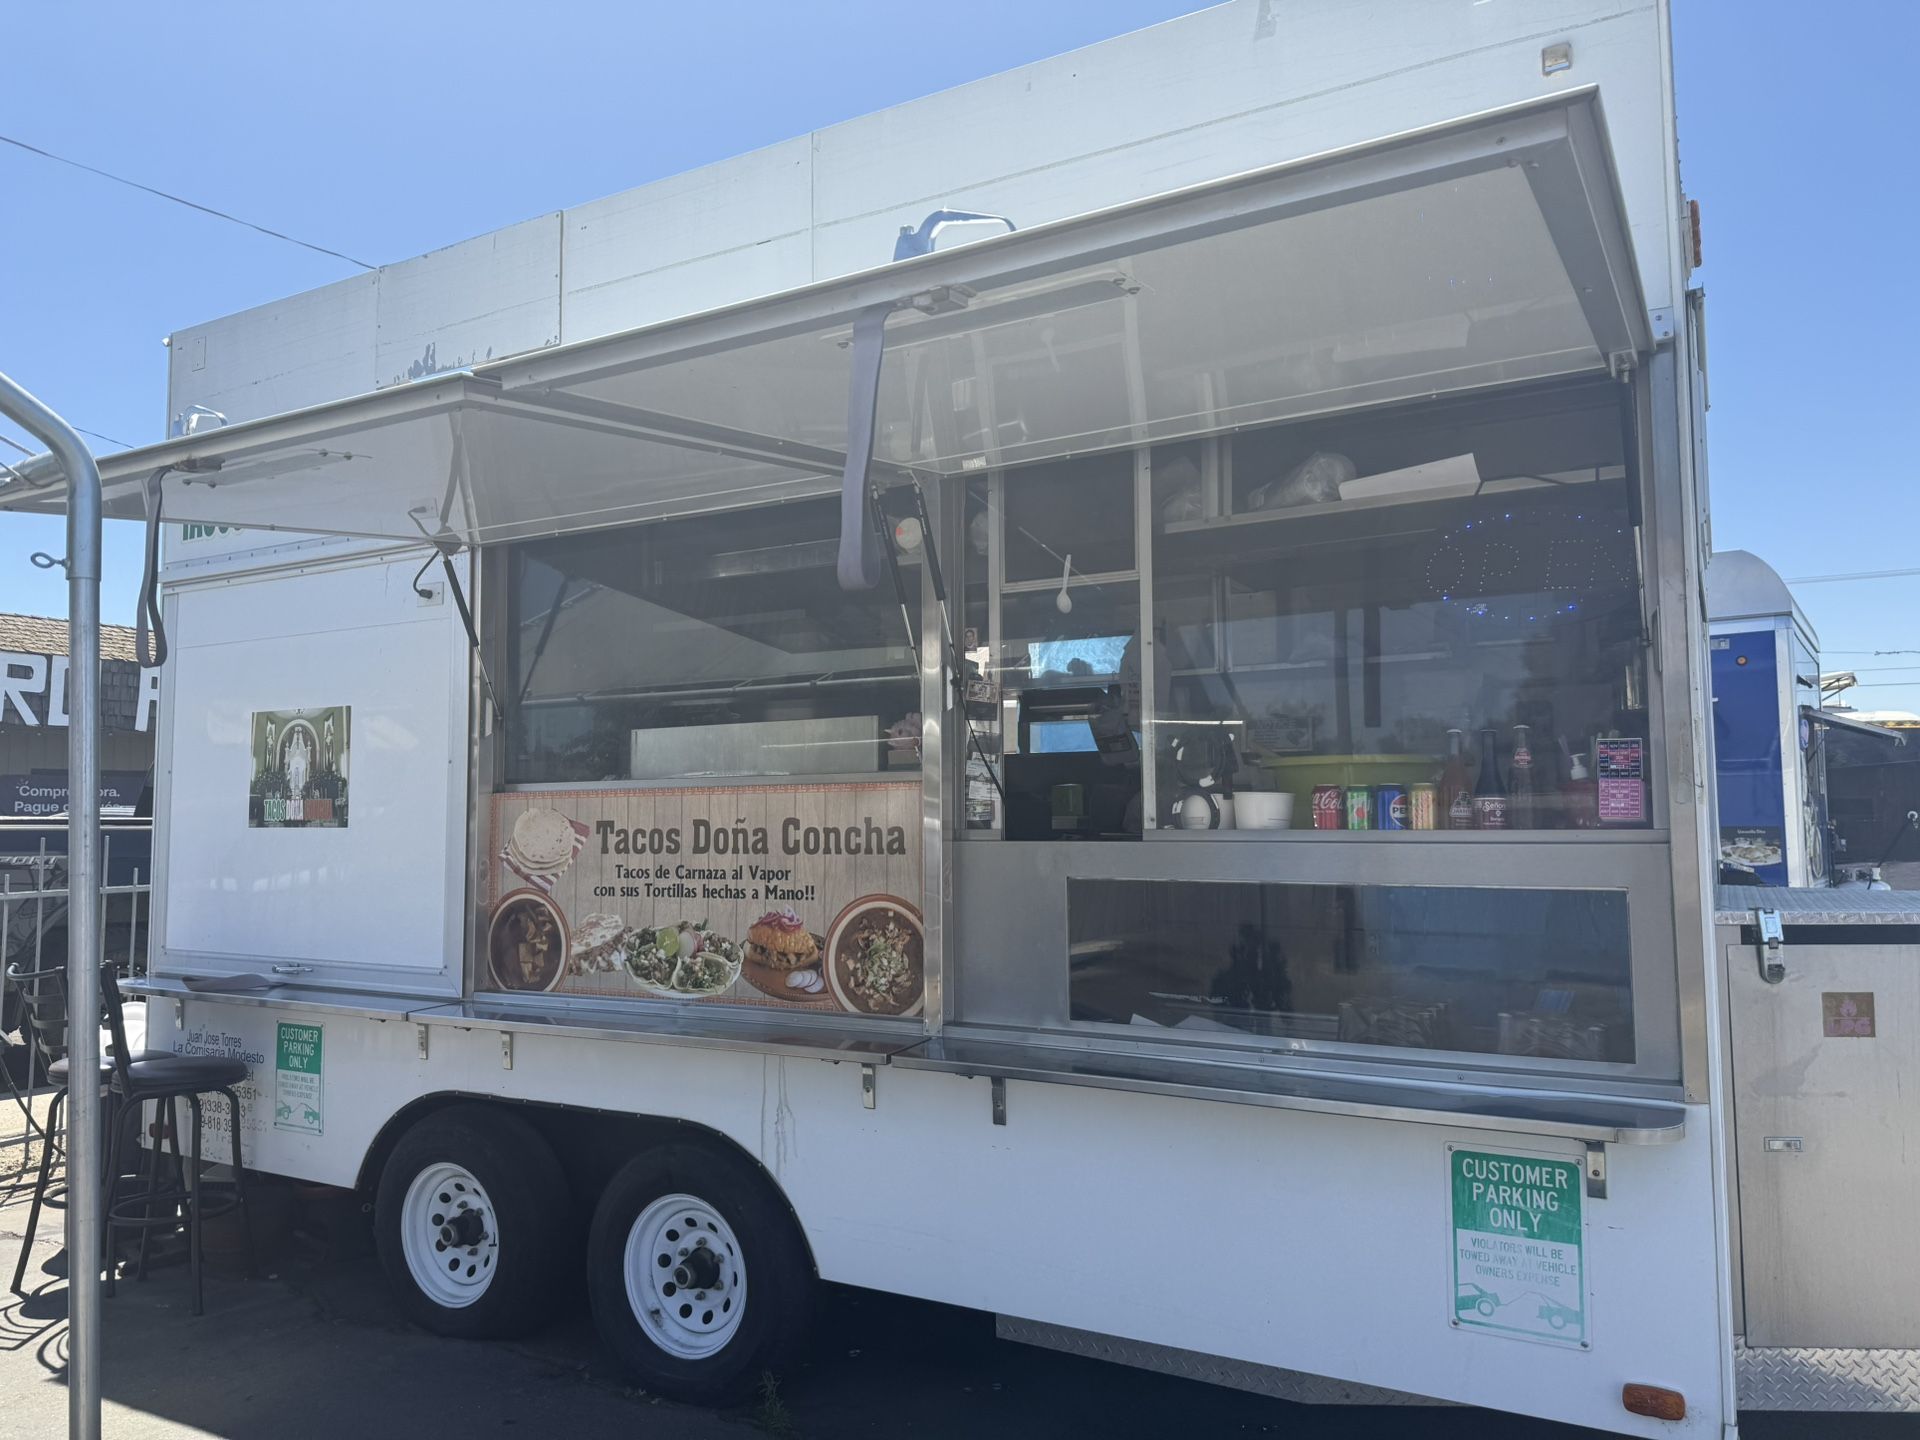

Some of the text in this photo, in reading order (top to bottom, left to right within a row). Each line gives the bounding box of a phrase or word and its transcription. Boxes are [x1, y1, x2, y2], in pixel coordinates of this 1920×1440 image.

[19, 785, 69, 799] Compr
[14, 801, 59, 815] Pague
[264, 799, 285, 821] TACOS
[595, 817, 906, 855] Tacos Doña Concha
[615, 864, 791, 884] Tacos de Carnaza al Vapor
[593, 883, 815, 901] con sus Tortillas hechas a Mano!!
[187, 1029, 242, 1048] Juan Jose Torres
[281, 1027, 319, 1043] CUSTOMER
[173, 1040, 183, 1053] La
[227, 1047, 265, 1064] Modesto
[283, 1041, 315, 1056] PARKING
[288, 1055, 308, 1069] ONLY
[1462, 1158, 1568, 1189] CUSTOMER
[1472, 1183, 1559, 1211] PARKING
[1489, 1208, 1542, 1232] ONLY
[1460, 1248, 1490, 1262] TOWED
[1536, 1260, 1577, 1276] VEHICLE
[1525, 1245, 1548, 1259] WILL
[1550, 1249, 1564, 1260] BE
[1475, 1264, 1514, 1280] OWNERS
